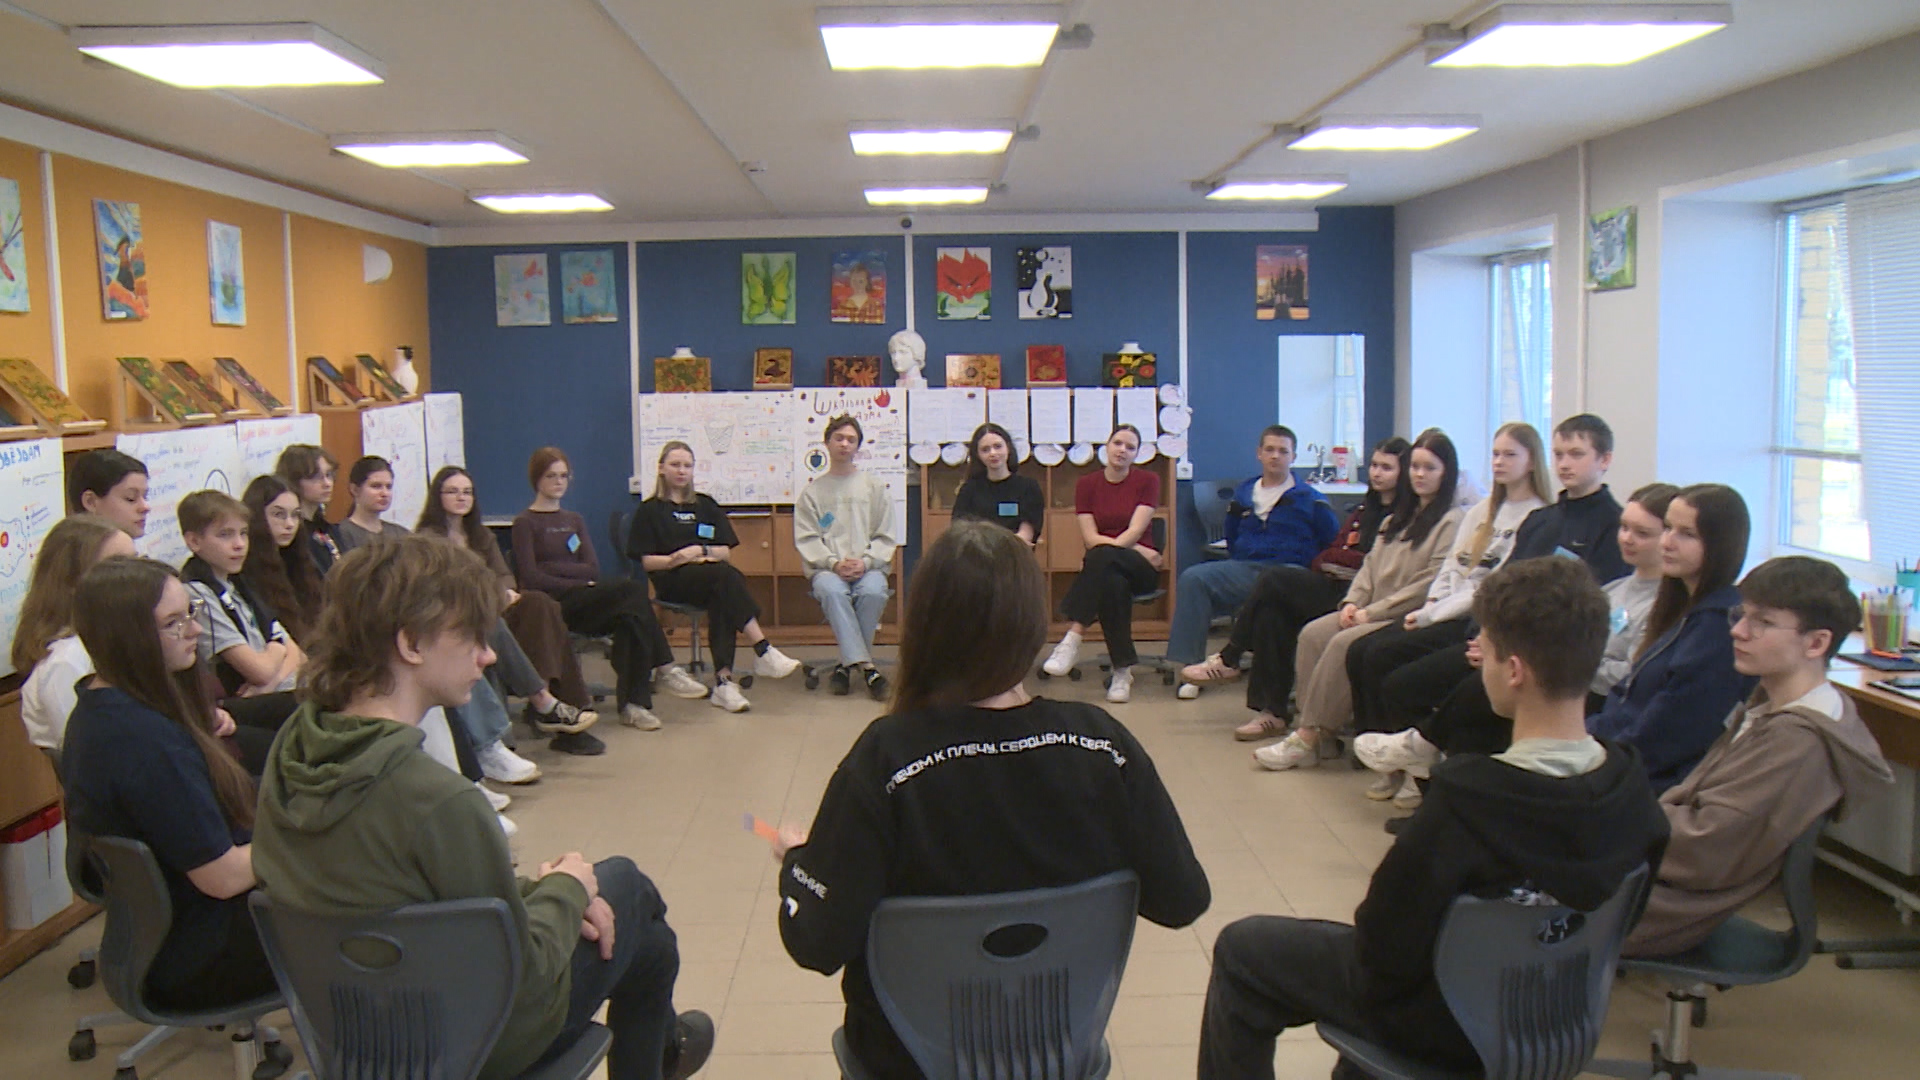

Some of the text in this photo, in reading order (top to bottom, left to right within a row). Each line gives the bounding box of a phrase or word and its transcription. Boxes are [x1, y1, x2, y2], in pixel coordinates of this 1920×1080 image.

[933, 749, 947, 762] К
[999, 733, 1067, 753] СЕРДЦЕМ
[1068, 733, 1079, 746] К
